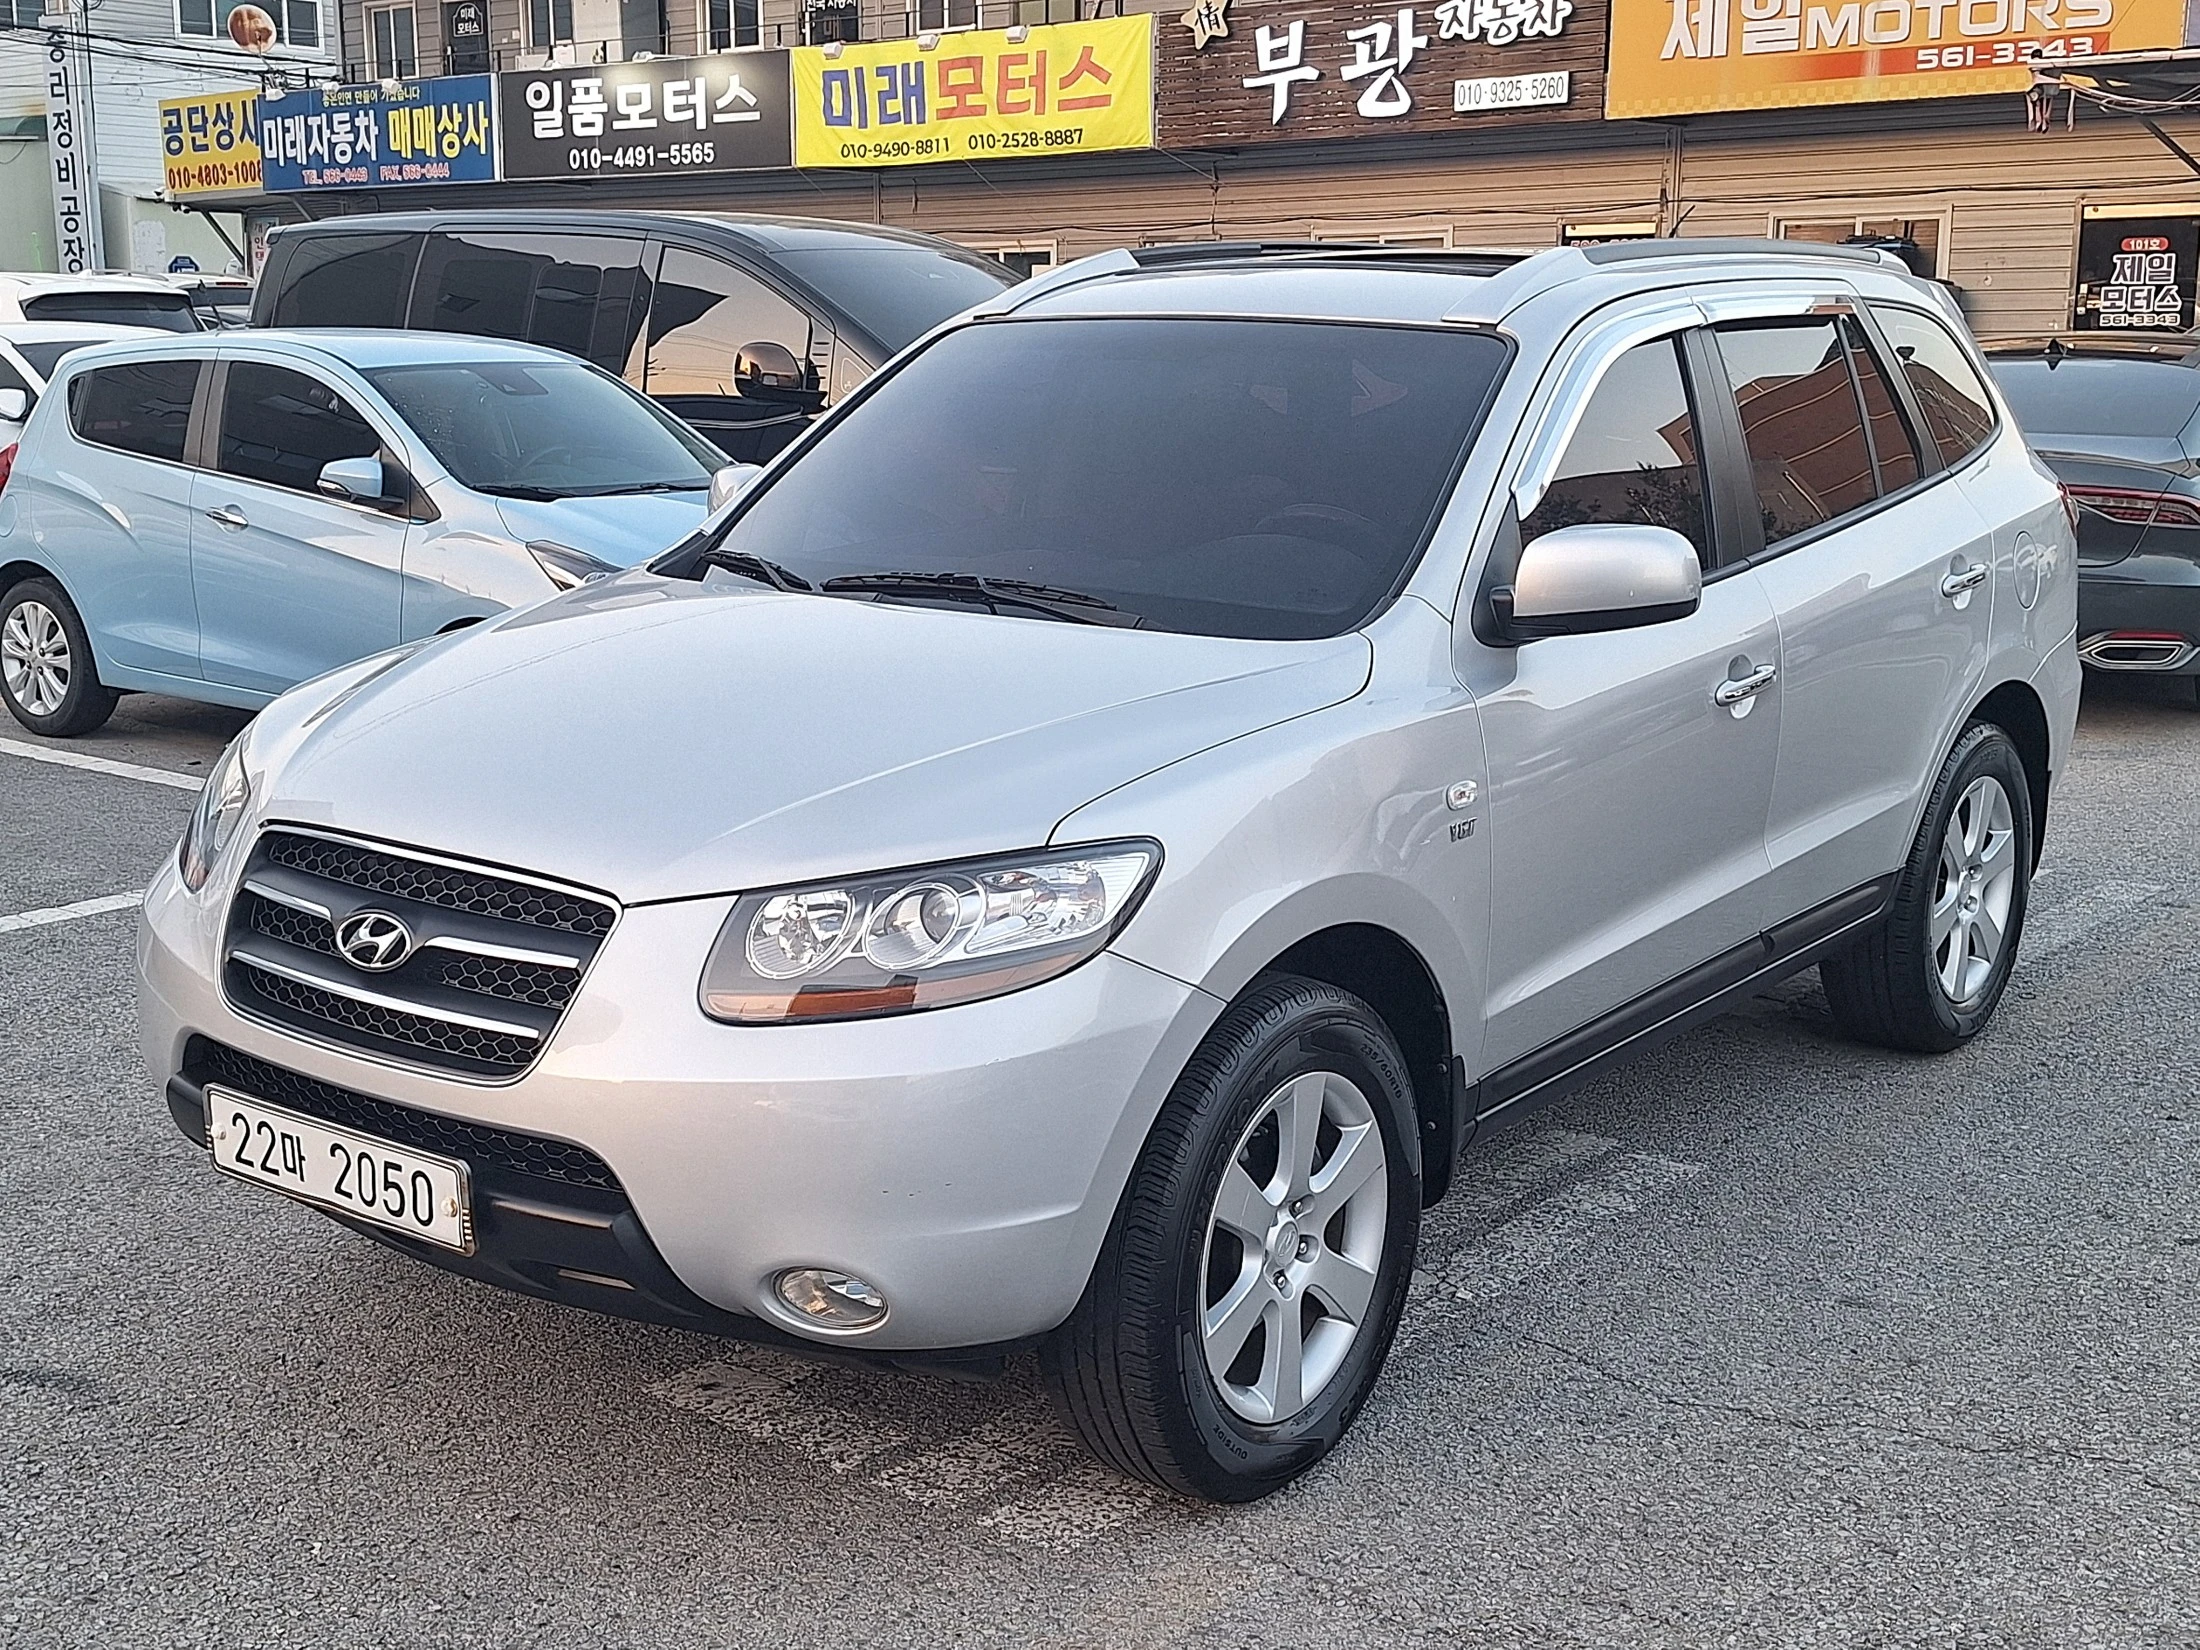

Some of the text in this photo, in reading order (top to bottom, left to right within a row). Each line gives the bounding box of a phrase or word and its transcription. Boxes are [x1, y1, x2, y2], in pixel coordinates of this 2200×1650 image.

[457, 21, 480, 34] 모터스
[460, 7, 475, 20] 미래
[1916, 36, 2094, 70] 561-3343
[526, 73, 761, 139] 일품모터스
[263, 100, 489, 167] 미래자동차 매매상사
[841, 128, 1084, 159] 010-9490-8811 010-2528-8887
[569, 142, 715, 171] 010-4491-5565
[2130, 239, 2160, 251] 101호
[2110, 253, 2176, 284] 제일
[2099, 285, 2182, 313] 모터스
[2099, 313, 2181, 327] 561-3343
[231, 1112, 434, 1227] 22마 2050
[1213, 1423, 1248, 1460] OUTSIDE
